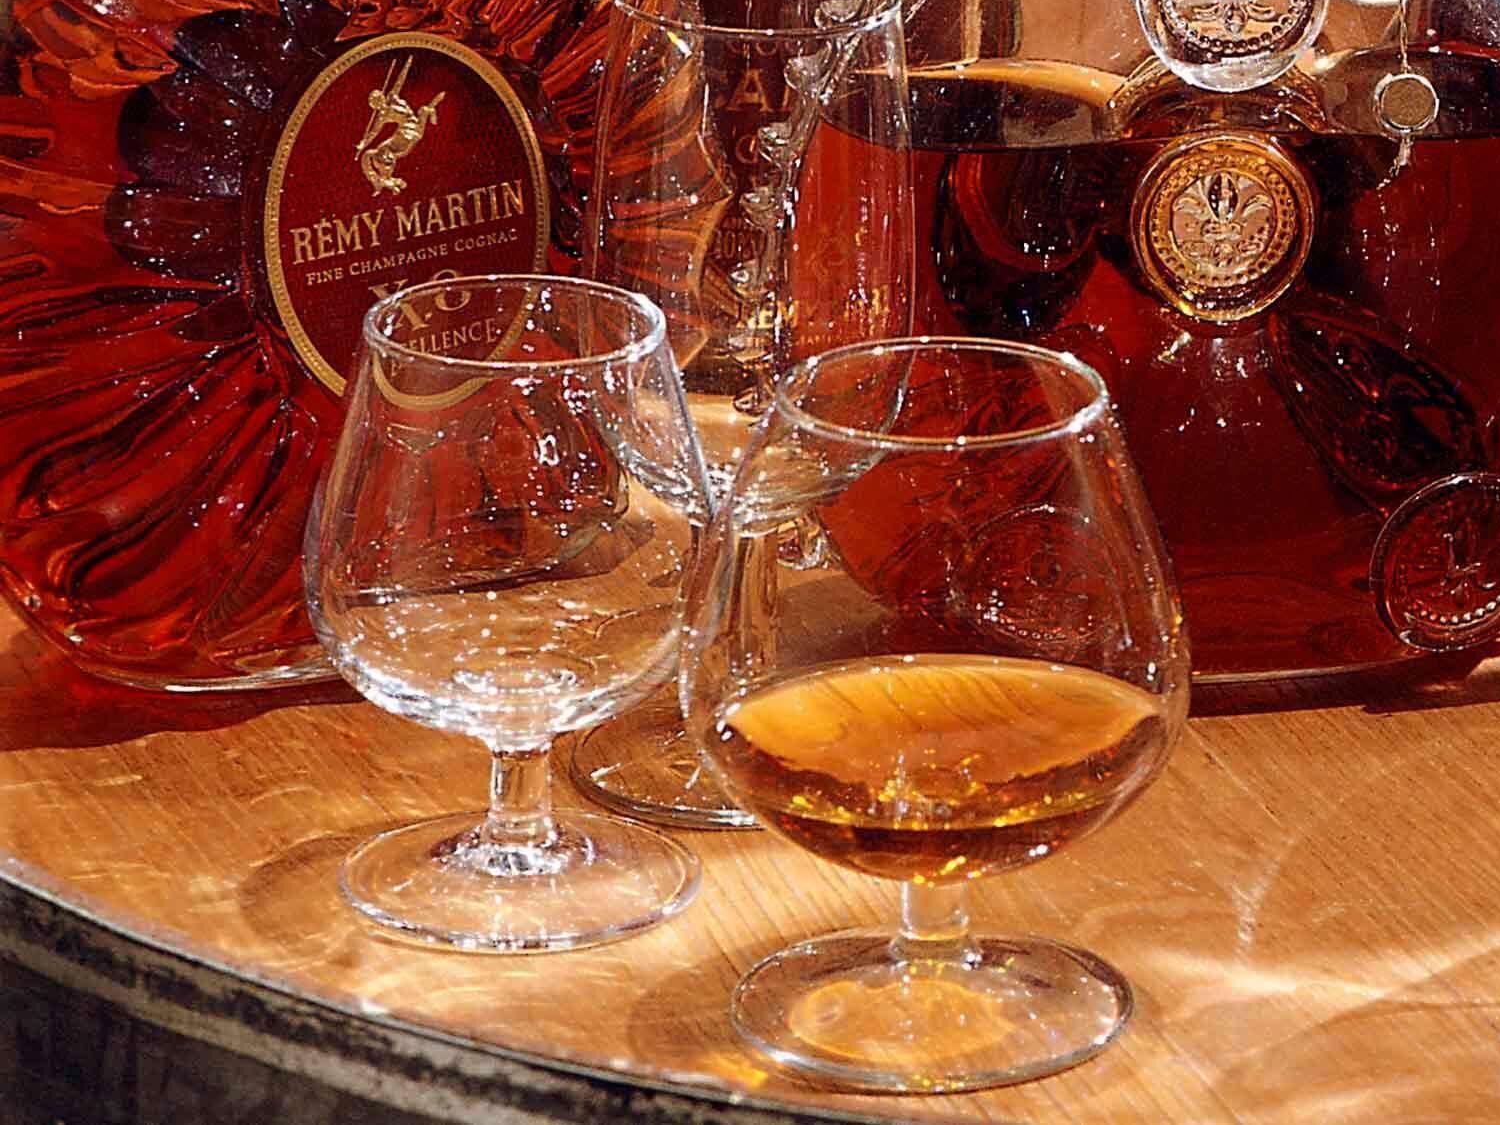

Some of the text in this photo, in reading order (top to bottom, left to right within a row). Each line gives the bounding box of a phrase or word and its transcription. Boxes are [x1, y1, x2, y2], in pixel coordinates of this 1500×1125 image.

[289, 178, 527, 266] RÉMY MARTIN
[306, 227, 520, 287] FINE CHAMPAGNE COGNAC
